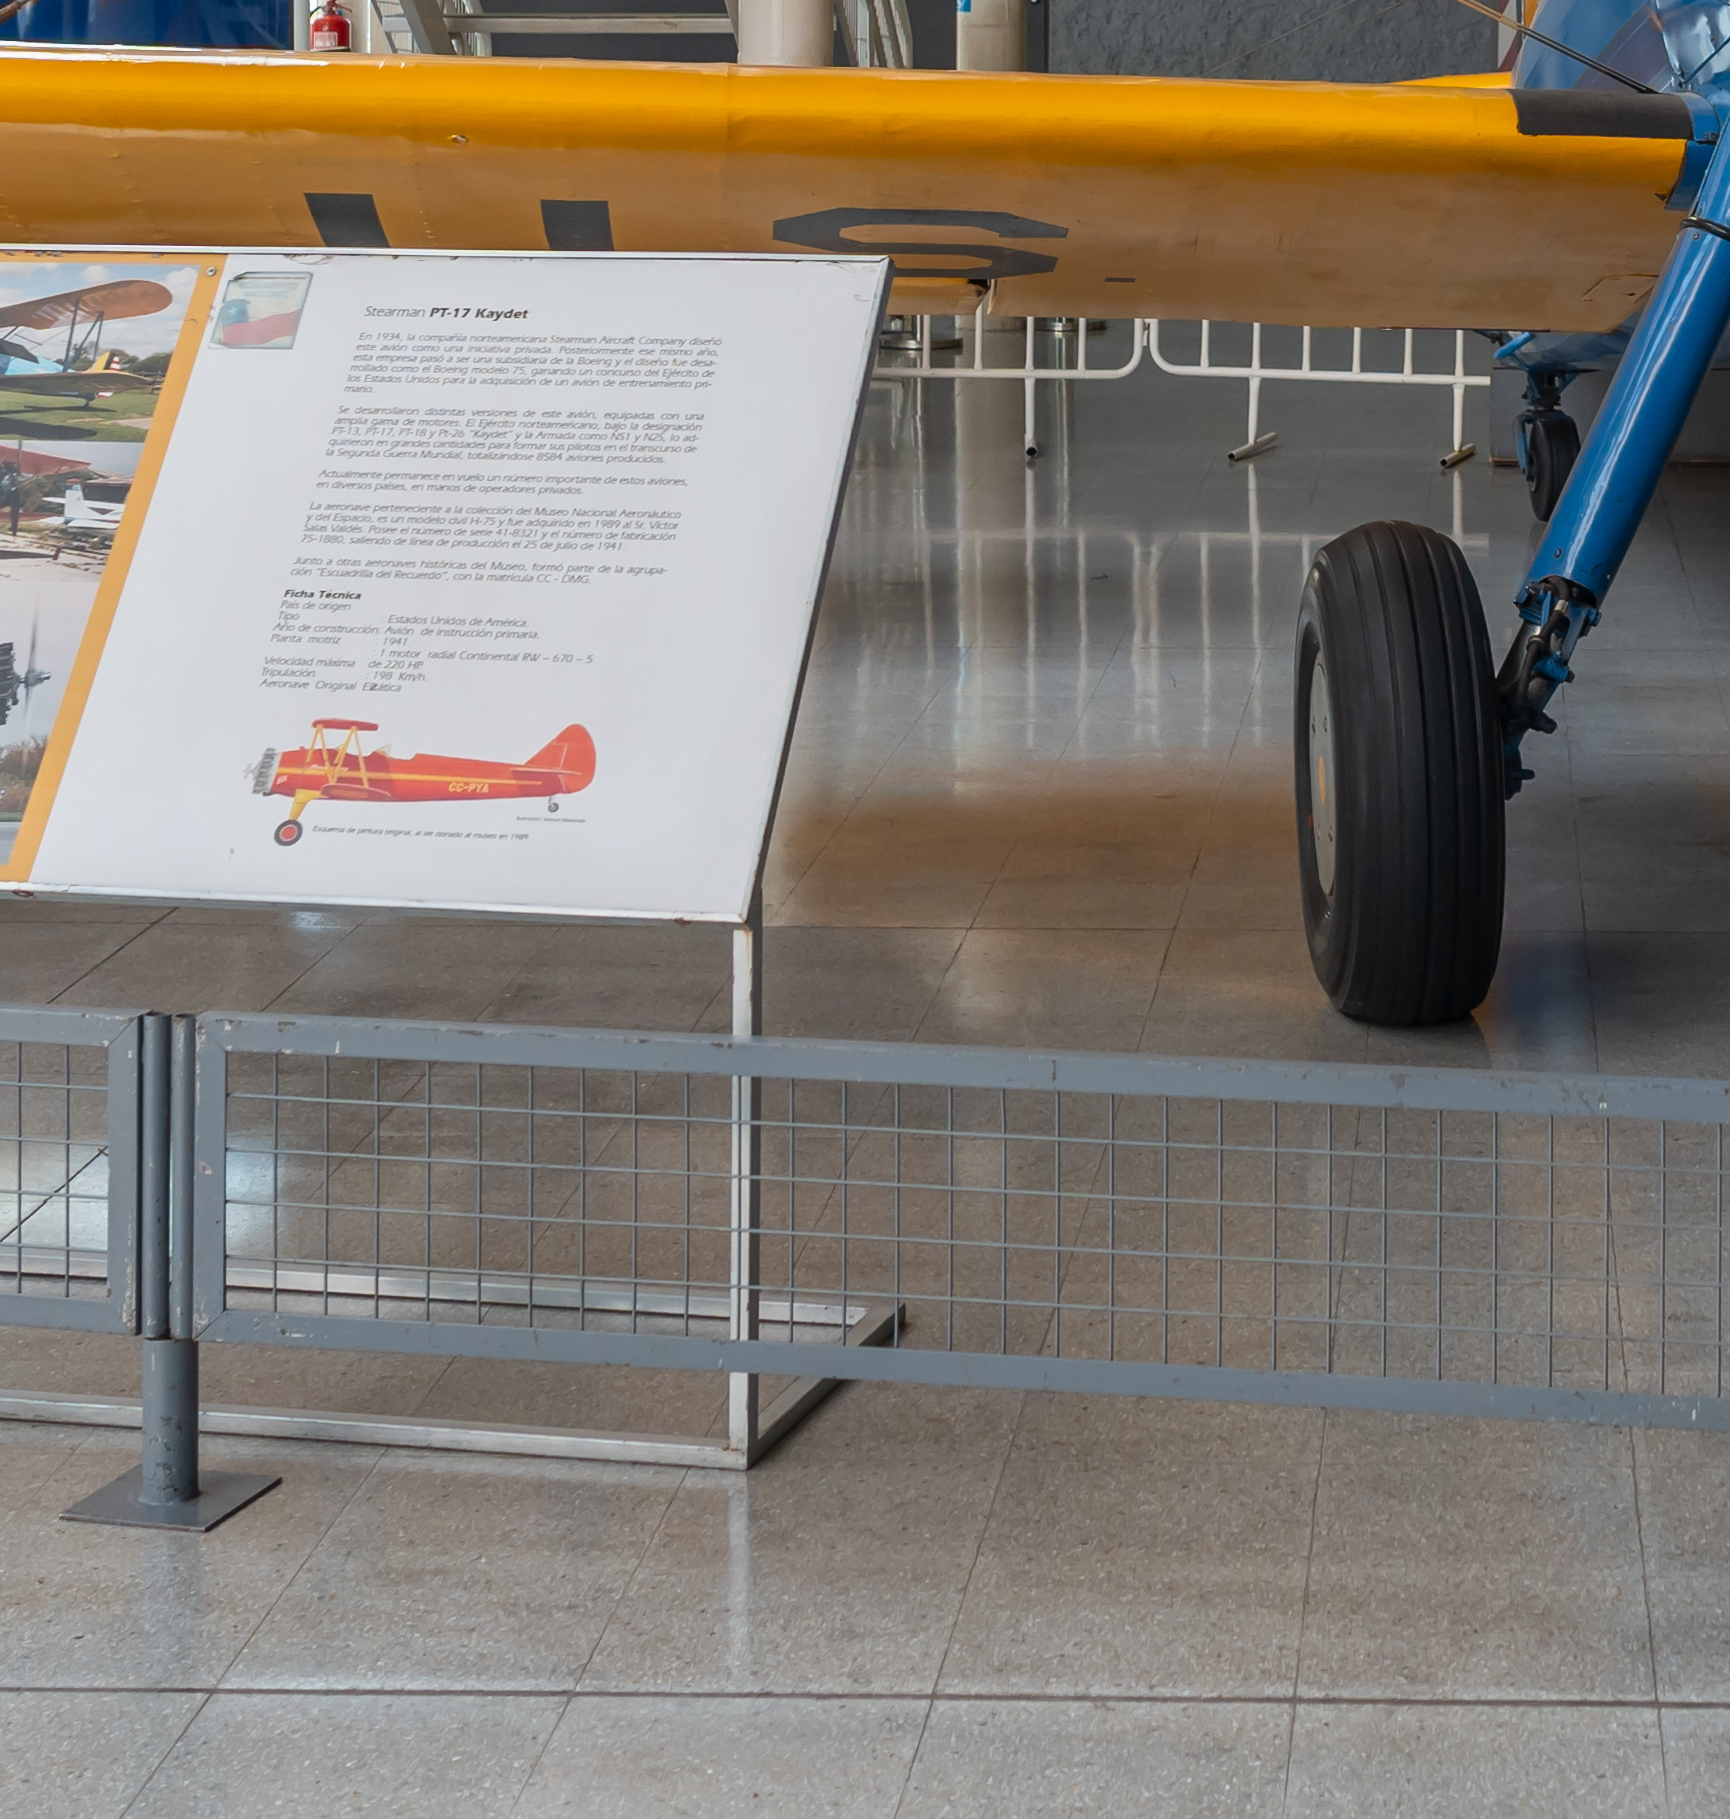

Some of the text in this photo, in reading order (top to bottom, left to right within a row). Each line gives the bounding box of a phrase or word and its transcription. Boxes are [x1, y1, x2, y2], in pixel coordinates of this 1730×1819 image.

[363, 306, 534, 322] Stearman PT-17 Kaydet
[375, 332, 686, 347] 1934, compañía norteamericana Stearman Aircraft Company
[466, 344, 510, 353] iniciativa
[558, 345, 634, 354] Posteriormente
[375, 355, 612, 367] empresa subsidiaria Boeing
[350, 363, 388, 372] rrollado
[433, 365, 468, 375] Boeing
[530, 366, 576, 377] ganando
[662, 368, 699, 379] Ejército
[363, 374, 692, 387] Estados Unidos adquisición entrenamiento
[354, 406, 654, 421] desarrollaron distintas versiones equipadas
[477, 418, 515, 429] Ejército
[518, 419, 600, 431] norteamericano,
[641, 422, 702, 433] designación
[331, 427, 361, 438] PT-13,
[365, 428, 395, 438] PT-17,
[398, 428, 427, 437] PT-18
[437, 429, 465, 437] Pt-26
[535, 431, 576, 439] Armada
[328, 437, 682, 453] quirieron grandes cantidades pilotos transcurso
[336, 448, 380, 459] Segunda
[382, 449, 417, 458] Guerra
[419, 450, 463, 461] Mundial,
[466, 450, 533, 460] totalizándose
[565, 453, 604, 462] aviones
[318, 469, 687, 487] Actualmente permanece importante aviones,
[331, 480, 372, 489] diversos
[374, 481, 406, 492] países,
[478, 484, 535, 495] operadores
[372, 503, 442, 515] perteneciente
[464, 505, 513, 514] colección
[533, 507, 569, 516] Museo
[570, 508, 617, 517] Nacional
[618, 509, 681, 518] Aeronáutico
[332, 513, 678, 529] Espacio, H-75 adquirido Víctor
[368, 525, 397, 533] Posee
[495, 528, 538, 537] 41-8321
[620, 531, 676, 540] fabricación
[348, 535, 391, 544] saliendo
[450, 538, 509, 550] producción
[294, 556, 322, 565] Junto
[419, 559, 467, 569] históricas
[489, 561, 527, 572] Museo,
[626, 567, 667, 576] agrupa-
[485, 572, 534, 582] matrícula
[283, 589, 361, 599] Ficha Técnica
[279, 600, 351, 612] País origen
[278, 611, 300, 622] Tipo
[387, 615, 427, 624] Estados
[429, 616, 467, 625] Unidos
[313, 623, 381, 633] construcción:
[384, 626, 414, 635] Avión
[436, 627, 492, 637] instrucción
[270, 633, 340, 643] Planta motriz
[262, 656, 315, 665] Velocidad
[383, 660, 406, 669] 220
[388, 649, 573, 662] motor radial Continental 670
[261, 667, 315, 679] Tripulación
[372, 672, 393, 680] 198
[259, 678, 309, 688] Aeronave
[314, 680, 357, 692] Original
